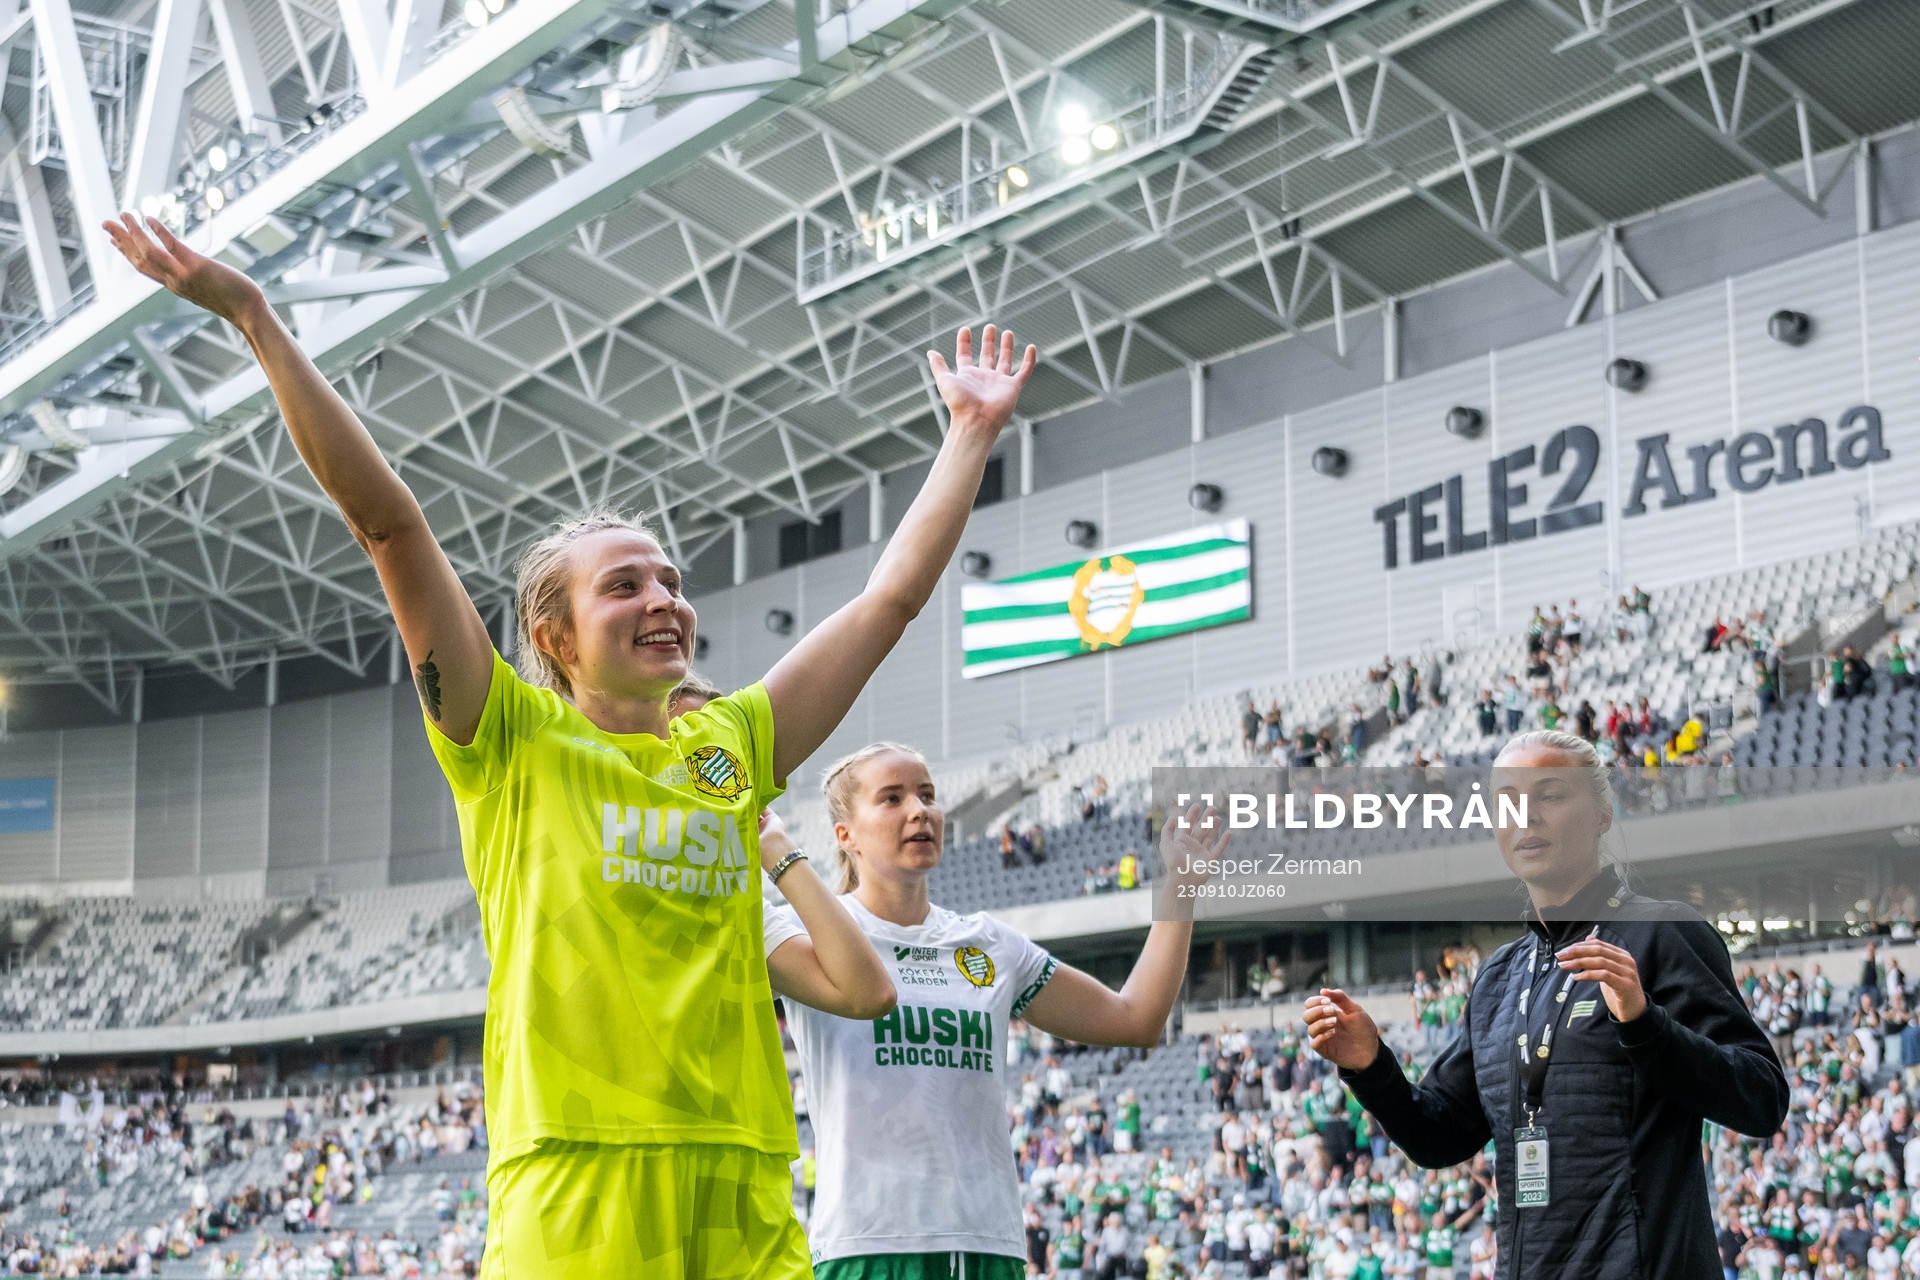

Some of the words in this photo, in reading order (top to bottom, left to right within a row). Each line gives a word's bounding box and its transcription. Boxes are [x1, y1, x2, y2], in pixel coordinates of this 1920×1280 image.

[1374, 424, 1603, 570] TELE2
[1622, 404, 1891, 517] Arena
[911, 954, 938, 962] SPORT
[912, 947, 938, 955] INTER
[873, 1004, 992, 1050] HUSKI
[875, 1047, 993, 1072] CHOCOLATE
[1522, 1192, 1542, 1202] 2023
